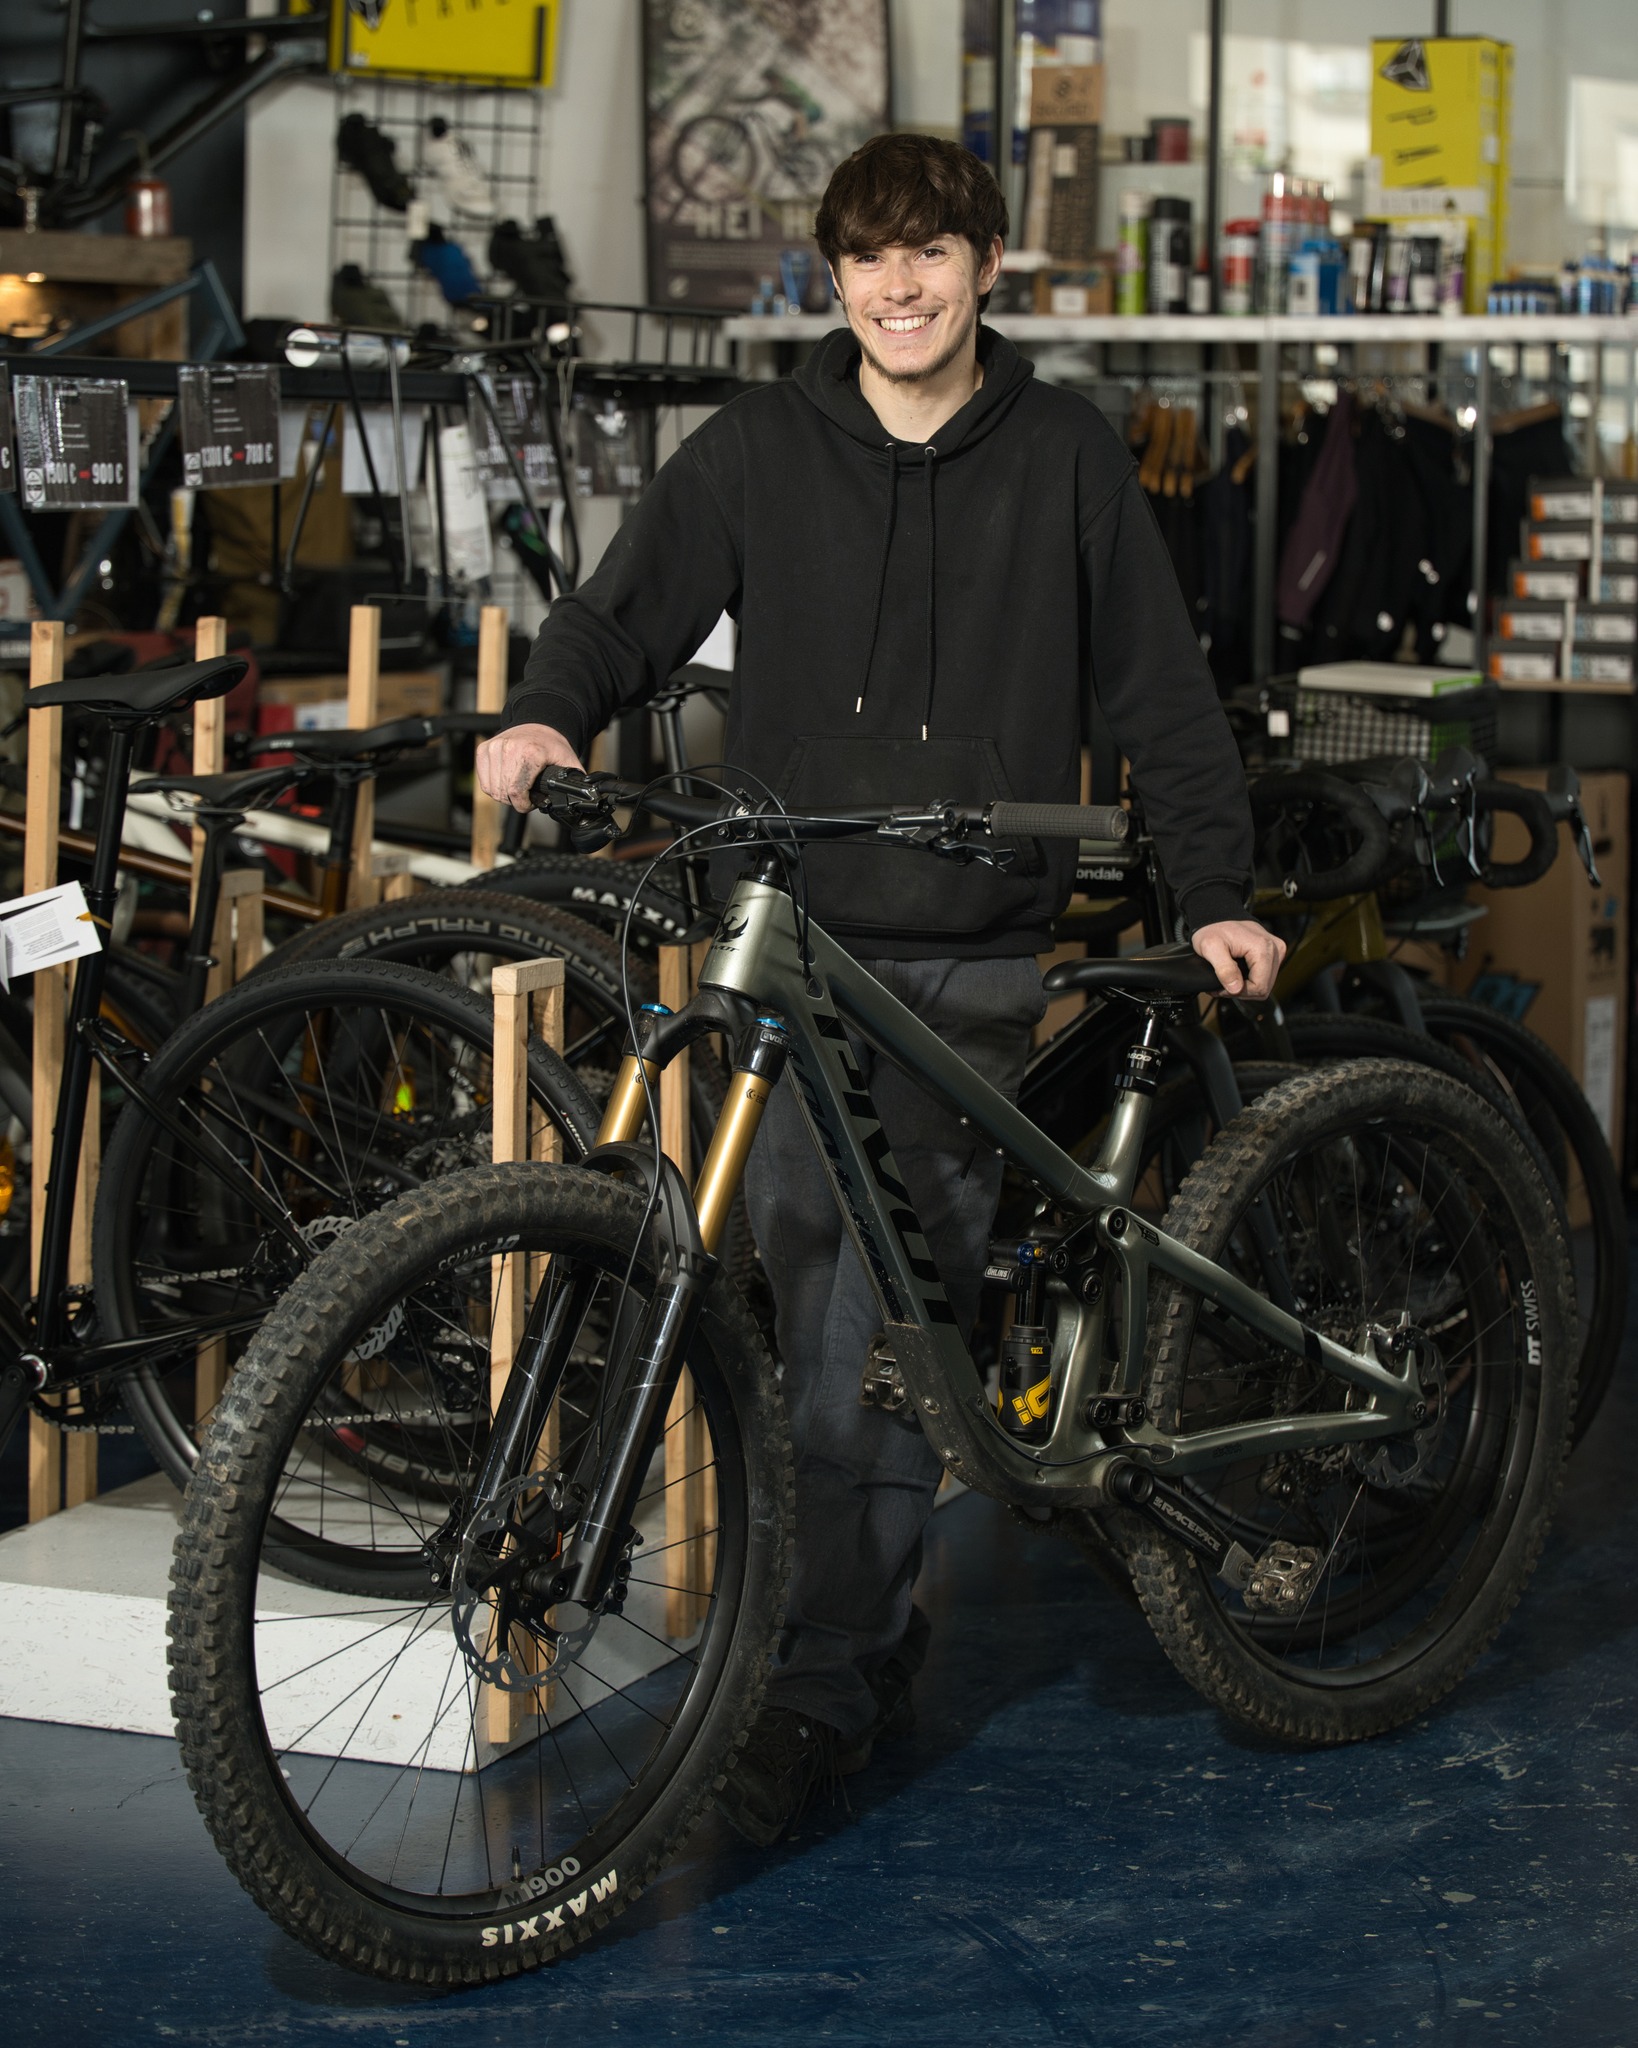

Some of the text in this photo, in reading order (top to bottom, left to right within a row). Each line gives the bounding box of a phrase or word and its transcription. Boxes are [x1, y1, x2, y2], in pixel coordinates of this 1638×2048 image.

[92, 462, 114, 485] 900
[115, 462, 124, 485] €
[1076, 866, 1124, 881] ondale
[368, 918, 619, 994] RACING RALPH
[439, 1234, 520, 1271] DT SWISS
[1520, 1279, 1542, 1366] DT SWISS
[503, 1857, 581, 1906] M1900
[481, 1868, 618, 1947] MAXXIS
